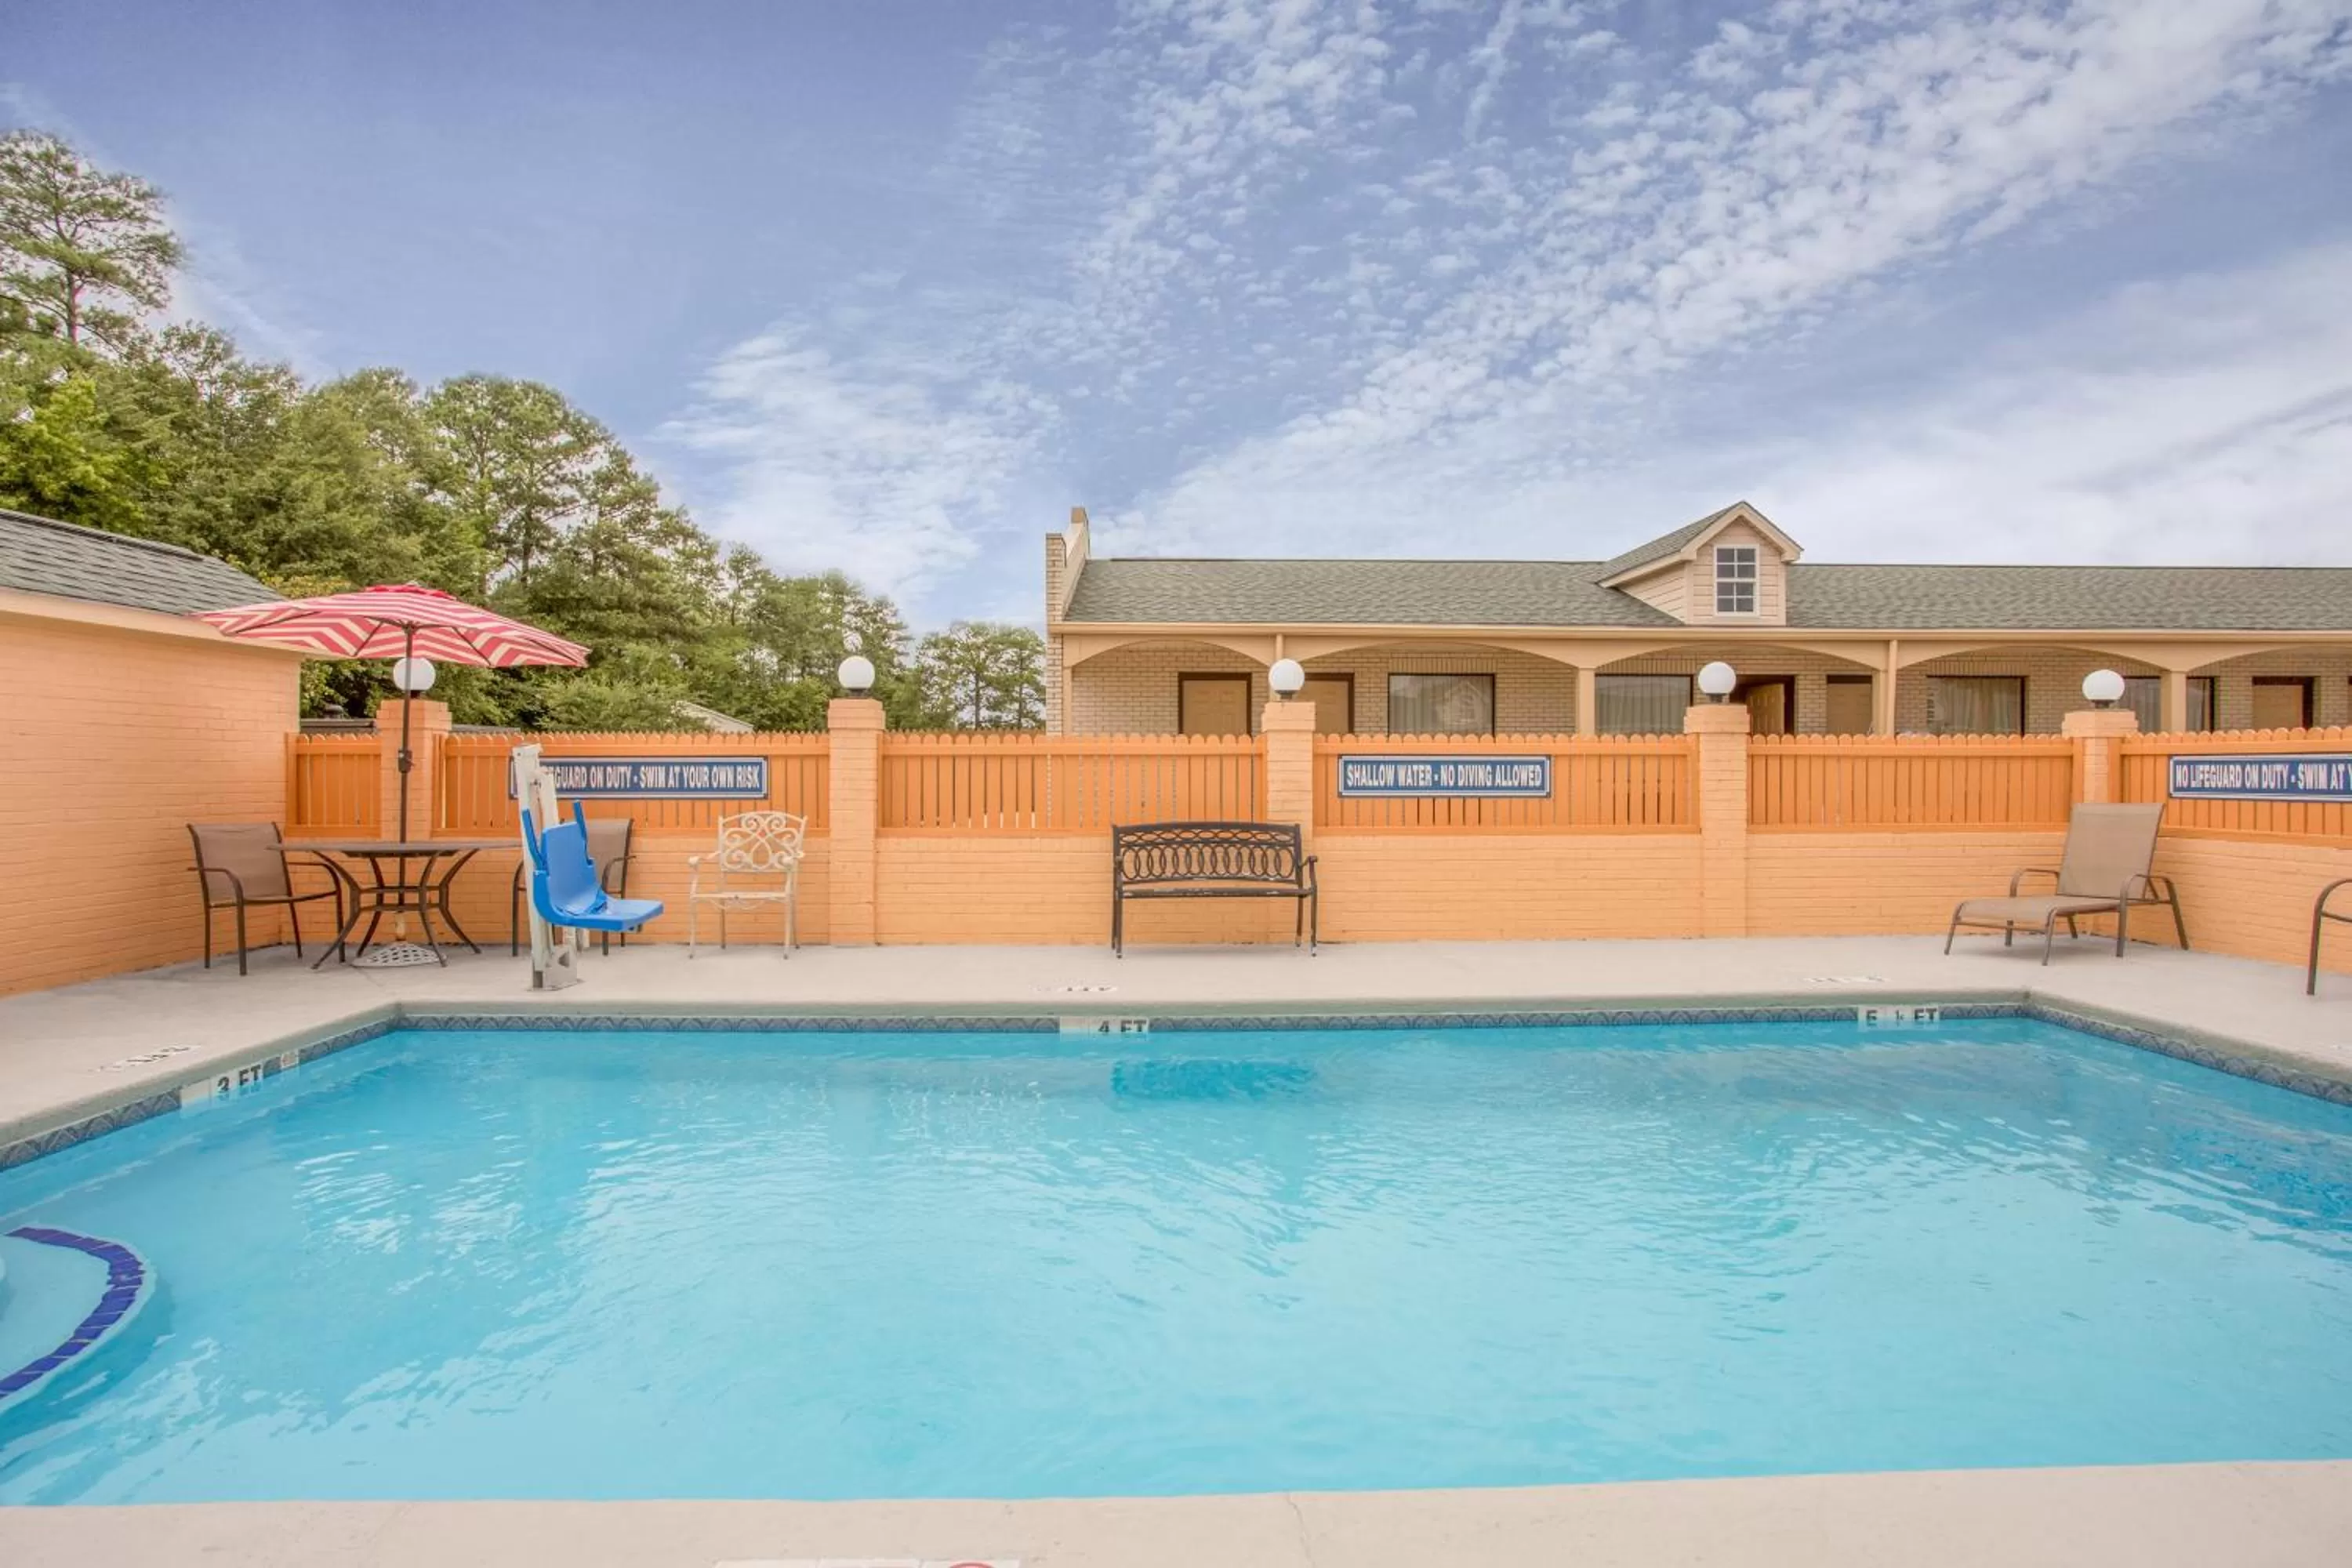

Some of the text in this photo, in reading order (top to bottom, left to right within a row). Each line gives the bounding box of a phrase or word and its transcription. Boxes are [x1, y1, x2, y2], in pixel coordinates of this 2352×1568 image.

[545, 765, 587, 789] GUARD
[590, 765, 604, 788] ON
[606, 765, 632, 788] DUTY
[640, 765, 666, 788] SWIM
[667, 765, 681, 788] AT
[682, 765, 710, 788] YOUR
[711, 765, 734, 788] OWN
[736, 765, 760, 788] RISK
[1347, 764, 1396, 787] SHALLOW
[1397, 764, 1432, 786] WATER
[1440, 764, 1455, 786] NO
[1457, 764, 1492, 786] DIVING
[1494, 764, 1542, 786] ALLOWED
[2176, 764, 2188, 787] NO
[2190, 764, 2241, 788] LIFEGUARD
[2245, 764, 2259, 788] ON
[2262, 764, 2289, 789] DUTY
[2298, 764, 2328, 789] SWIM
[2330, 763, 2345, 790] AT
[1914, 1008, 1937, 1020] FT
[1098, 1020, 1147, 1033] 4 FT
[239, 1064, 261, 1086] FT
